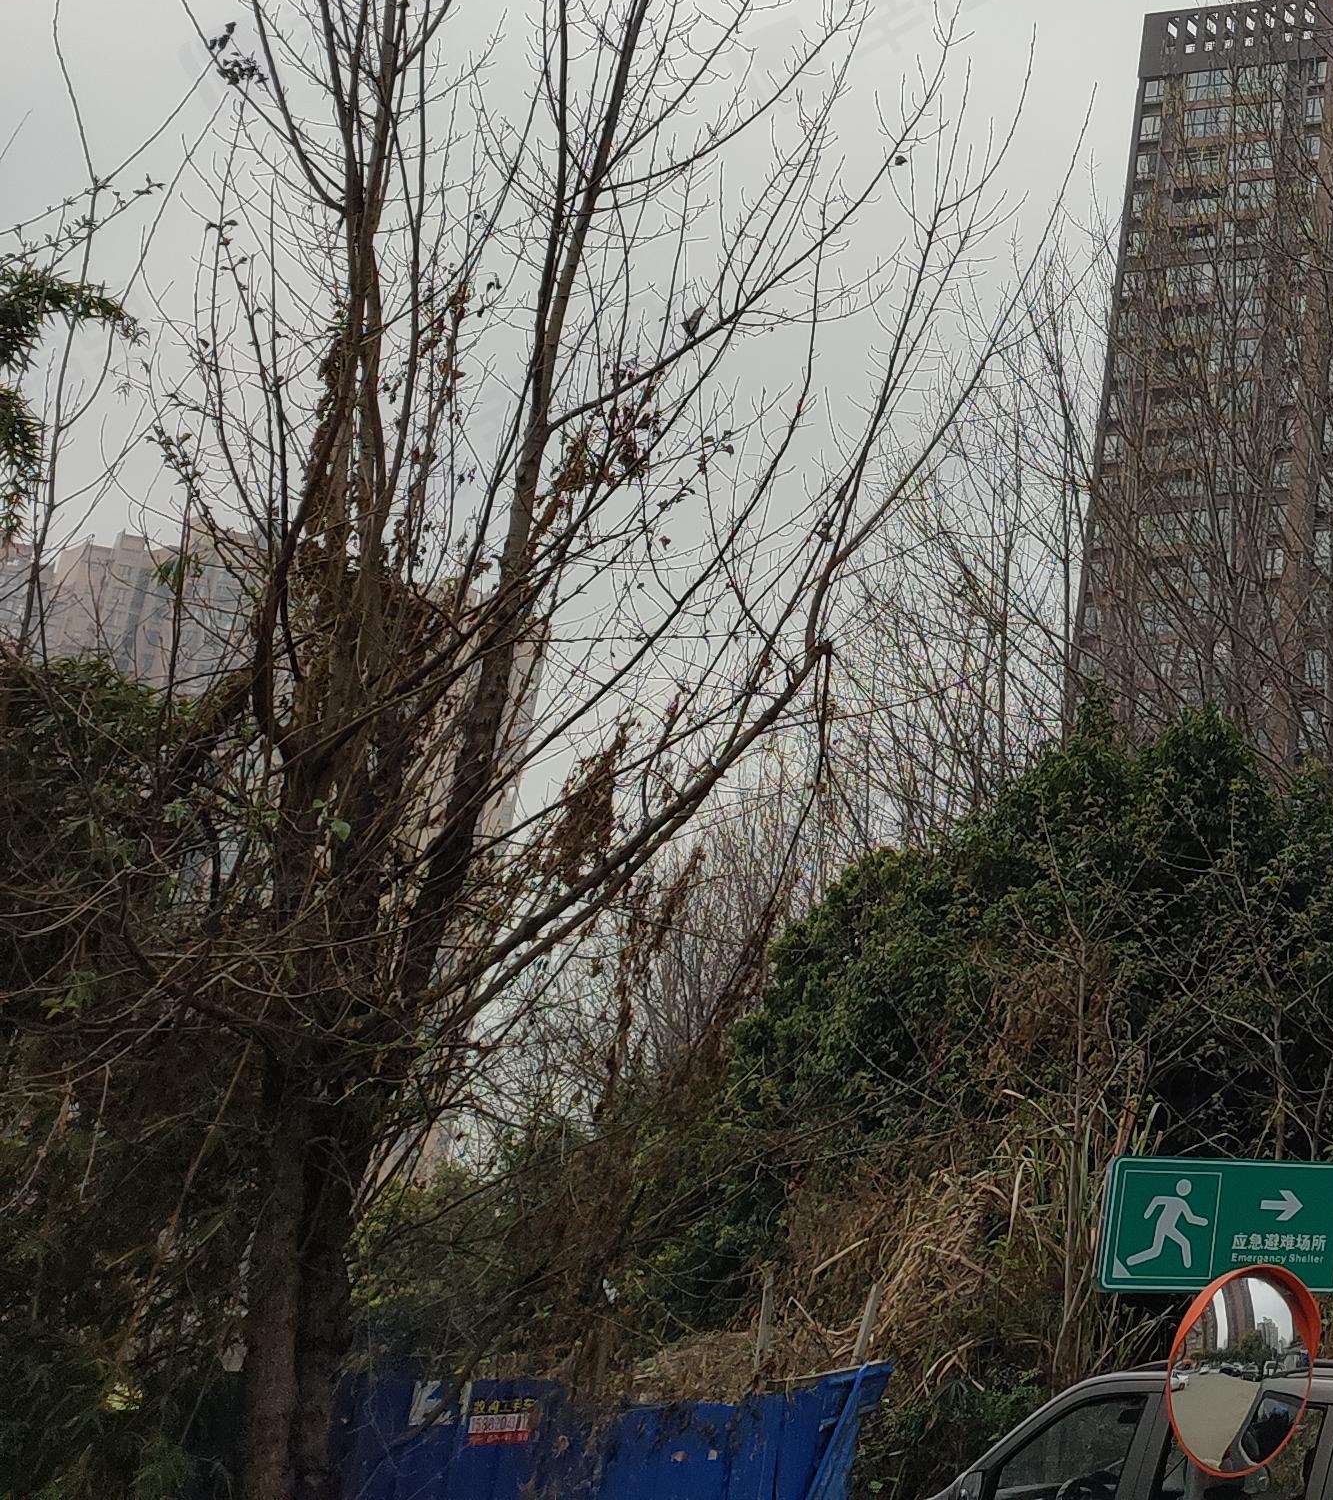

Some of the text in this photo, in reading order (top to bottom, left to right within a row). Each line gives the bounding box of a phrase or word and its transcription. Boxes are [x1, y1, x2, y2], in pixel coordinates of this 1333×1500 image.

[1231, 1232, 1327, 1252] 应急避难场所
[1231, 1253, 1324, 1264] Emergency Shelter
